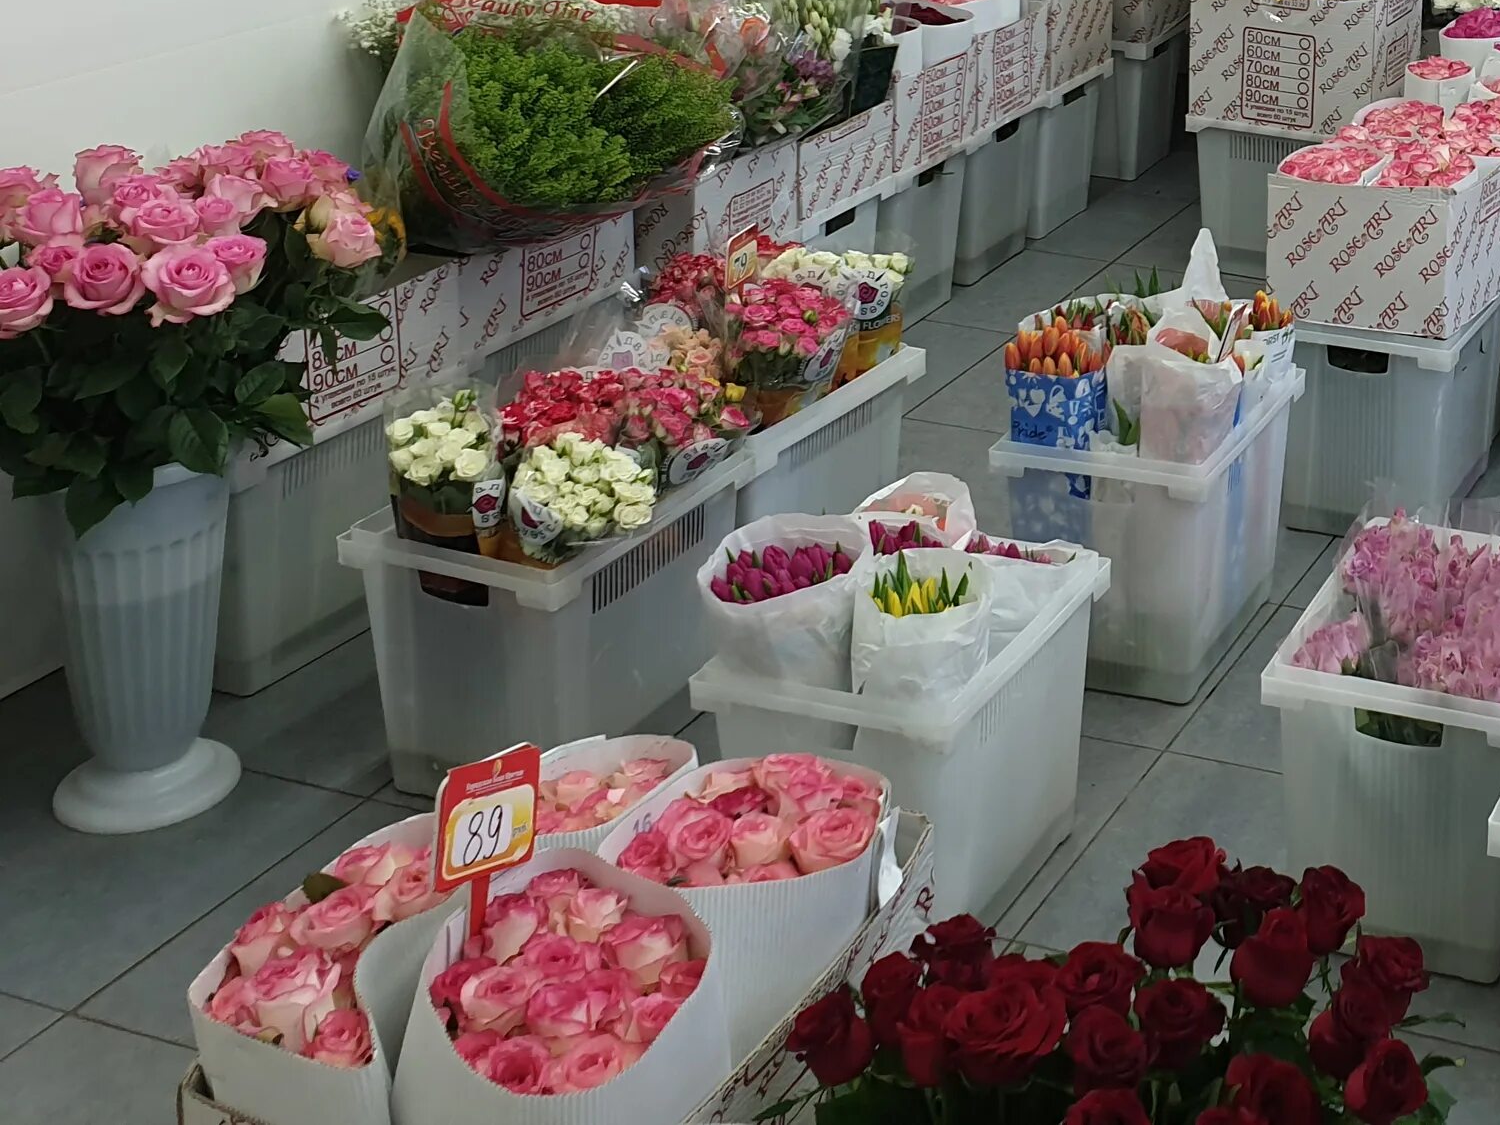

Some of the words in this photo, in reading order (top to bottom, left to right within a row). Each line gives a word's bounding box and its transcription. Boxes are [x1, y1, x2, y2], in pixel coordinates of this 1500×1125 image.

[1247, 31, 1281, 46] 50см
[1247, 45, 1280, 61] 60см
[1246, 59, 1280, 76] 70см
[1246, 74, 1280, 90] 80см
[1245, 89, 1279, 105] 90см
[1275, 191, 1304, 231] ART
[1285, 231, 1321, 268] ROSE
[1318, 197, 1348, 235] ART
[1329, 236, 1365, 273] ROSE
[1363, 201, 1393, 239] ART
[1374, 241, 1410, 278] ROSE
[1409, 205, 1439, 245] ART
[1291, 280, 1321, 318] ART
[1334, 285, 1365, 324] ART
[1379, 291, 1409, 329] ART
[1424, 297, 1451, 335] ART
[312, 341, 357, 370] 8см
[464, 805, 503, 866] 89
